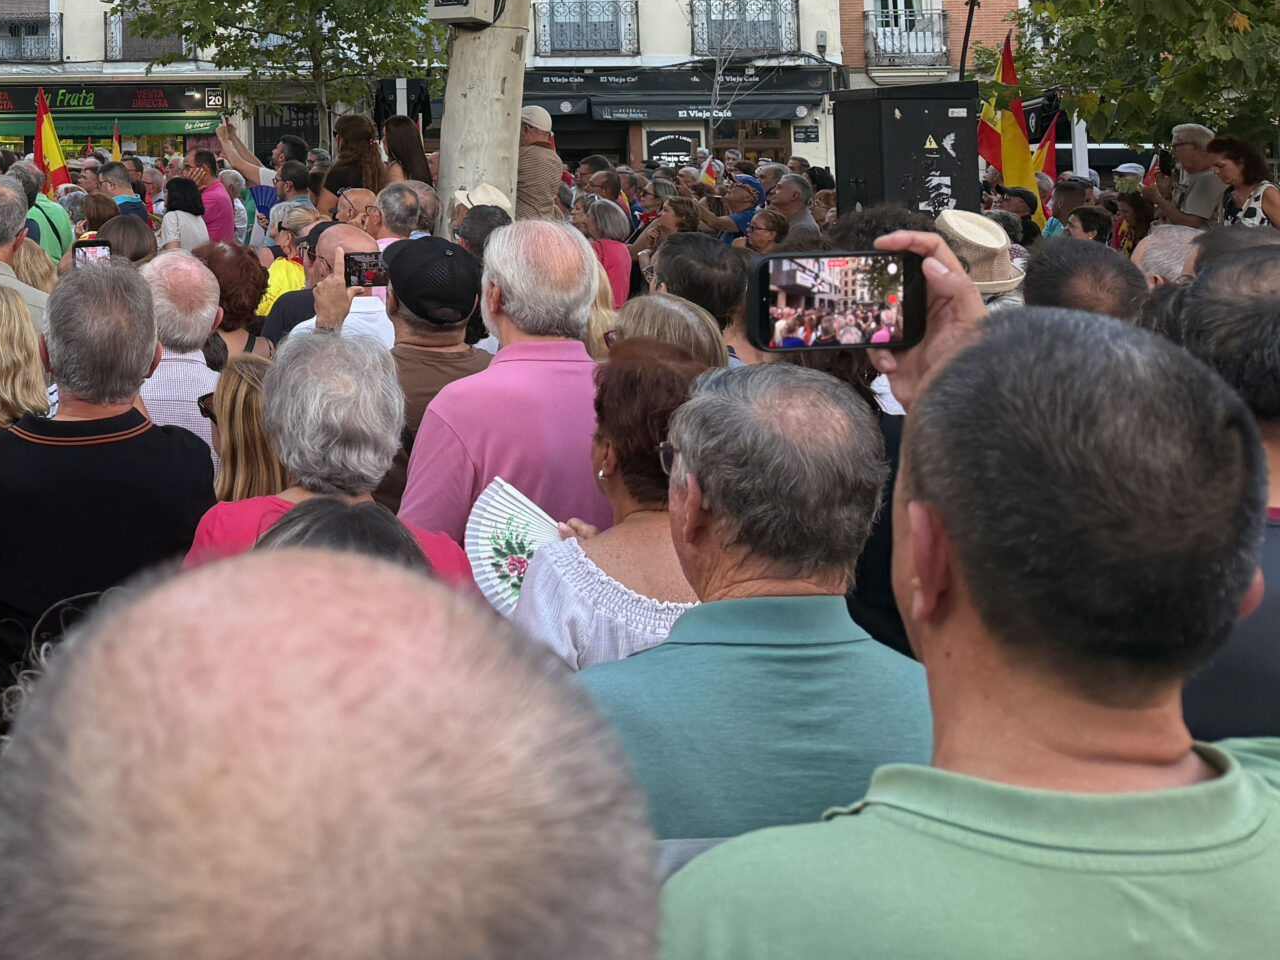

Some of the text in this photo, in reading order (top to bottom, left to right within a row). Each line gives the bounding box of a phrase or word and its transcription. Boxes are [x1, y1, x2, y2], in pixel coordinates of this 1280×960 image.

[56, 89, 95, 107] Fruta
[136, 90, 164, 99] VENTA
[131, 99, 169, 108] DIRECTA
[208, 96, 223, 105] 20
[688, 110, 710, 118] Viejo
